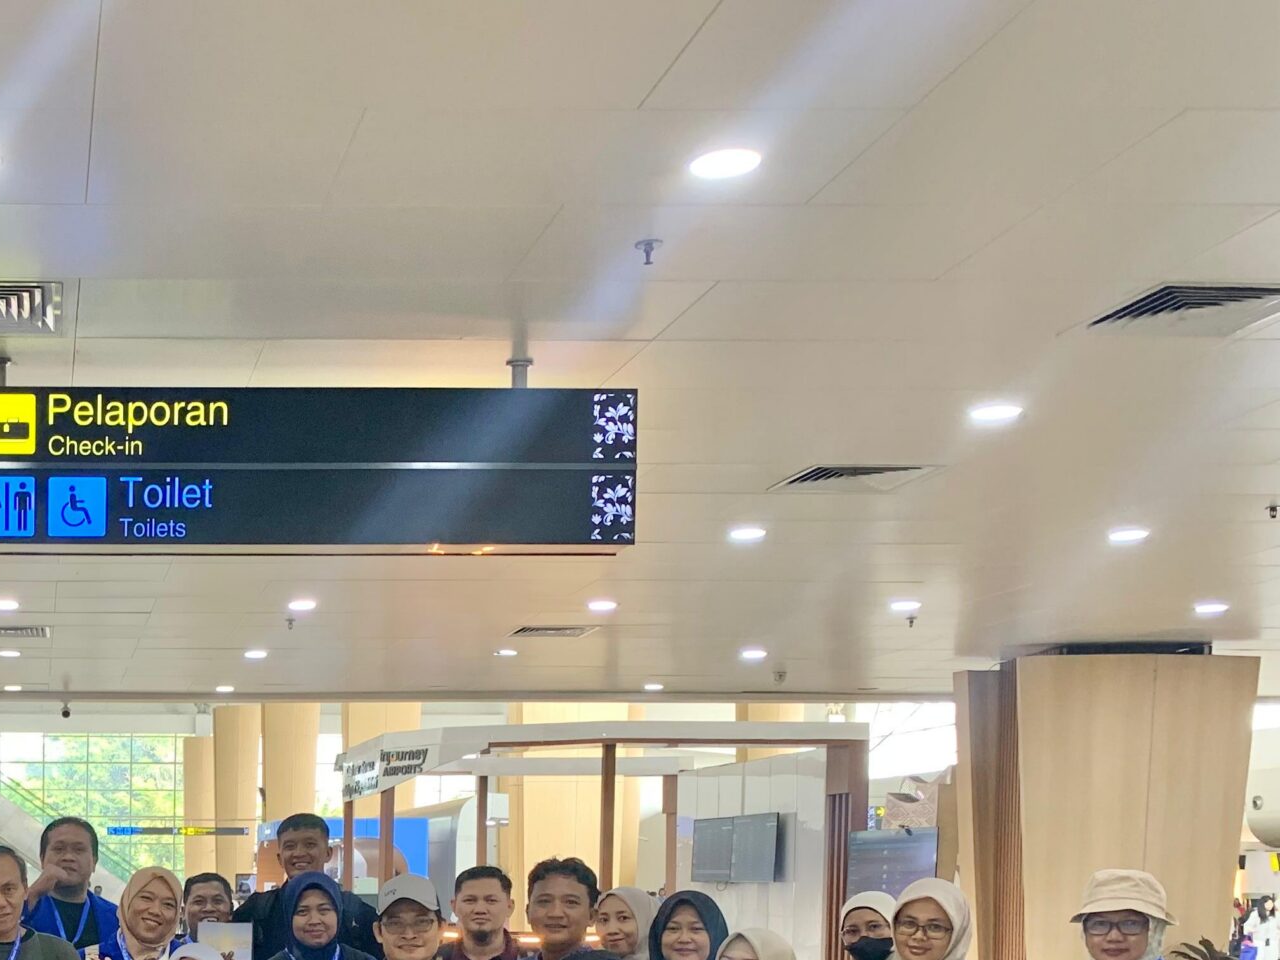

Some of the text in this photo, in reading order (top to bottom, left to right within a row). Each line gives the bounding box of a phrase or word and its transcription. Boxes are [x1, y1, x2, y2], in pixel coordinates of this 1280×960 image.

[48, 394, 228, 433] Pelaporan
[48, 436, 143, 456] Check-in
[120, 476, 213, 509] Toilet
[120, 517, 186, 538] Toilets
[383, 764, 423, 777] AIRPORTS
